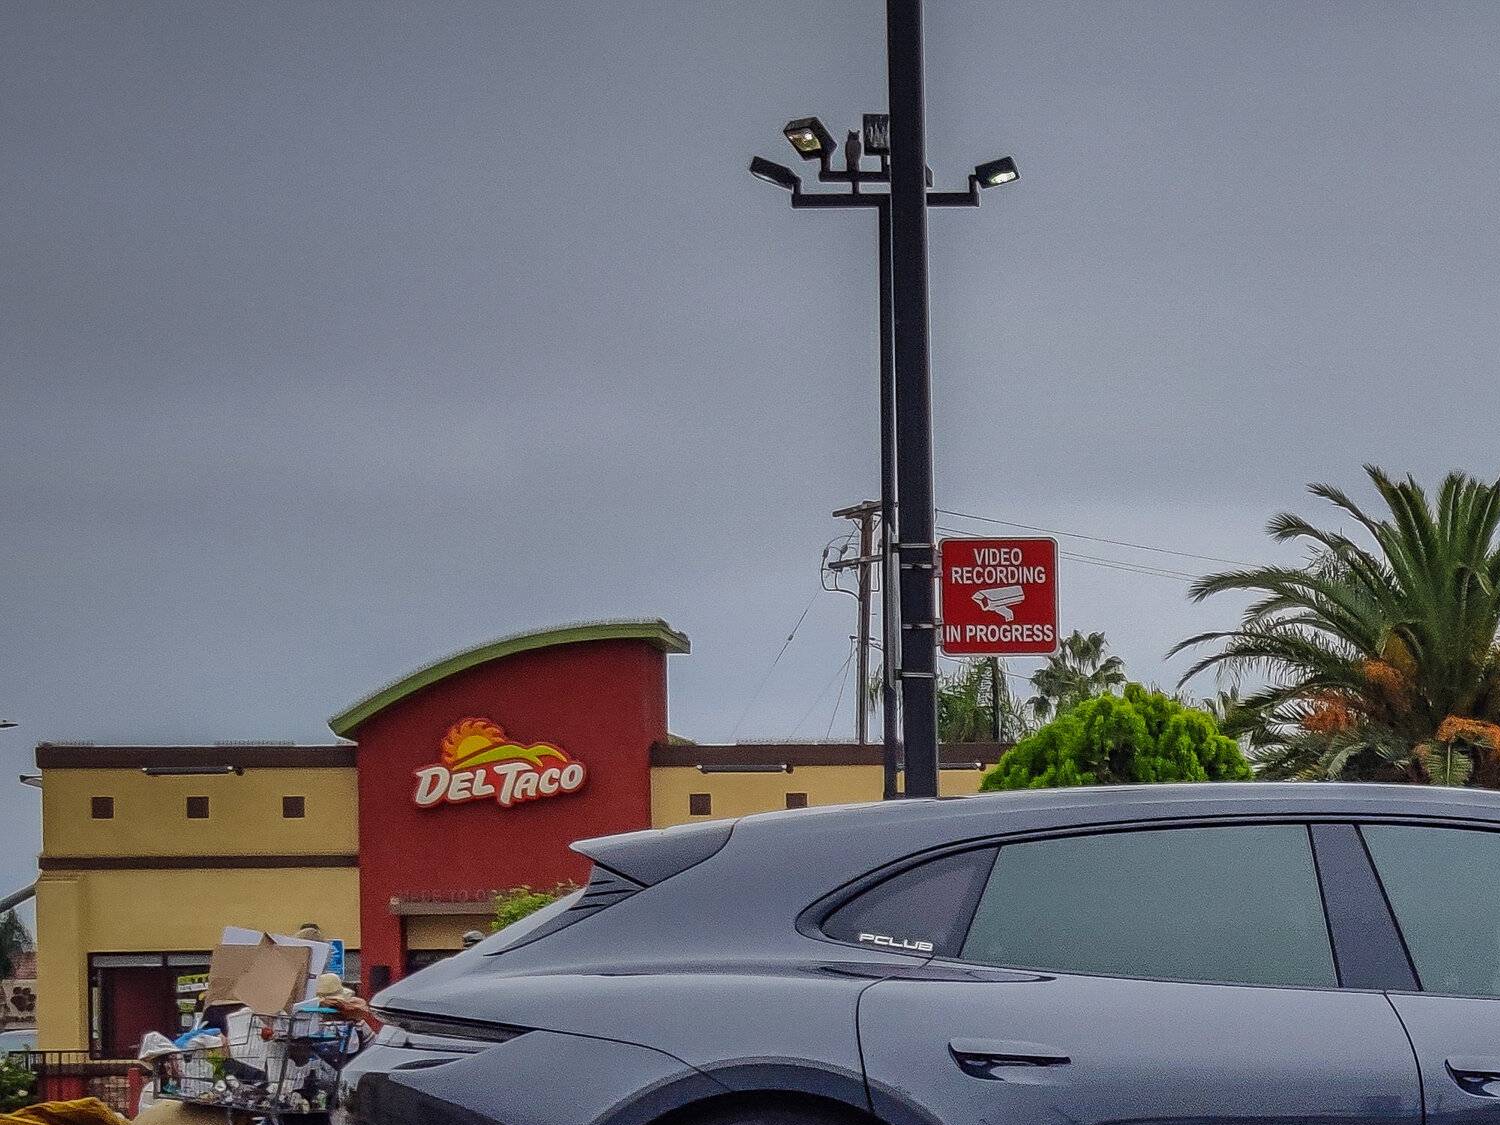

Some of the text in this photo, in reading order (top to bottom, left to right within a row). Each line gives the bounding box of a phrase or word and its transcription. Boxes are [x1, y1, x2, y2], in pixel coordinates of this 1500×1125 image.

[973, 548, 1023, 566] VIDEO
[951, 566, 1046, 584] RECORDING
[946, 624, 1054, 643] IN PROGRESS
[416, 762, 584, 805] DEL TACO
[859, 933, 934, 952] PCLUB
